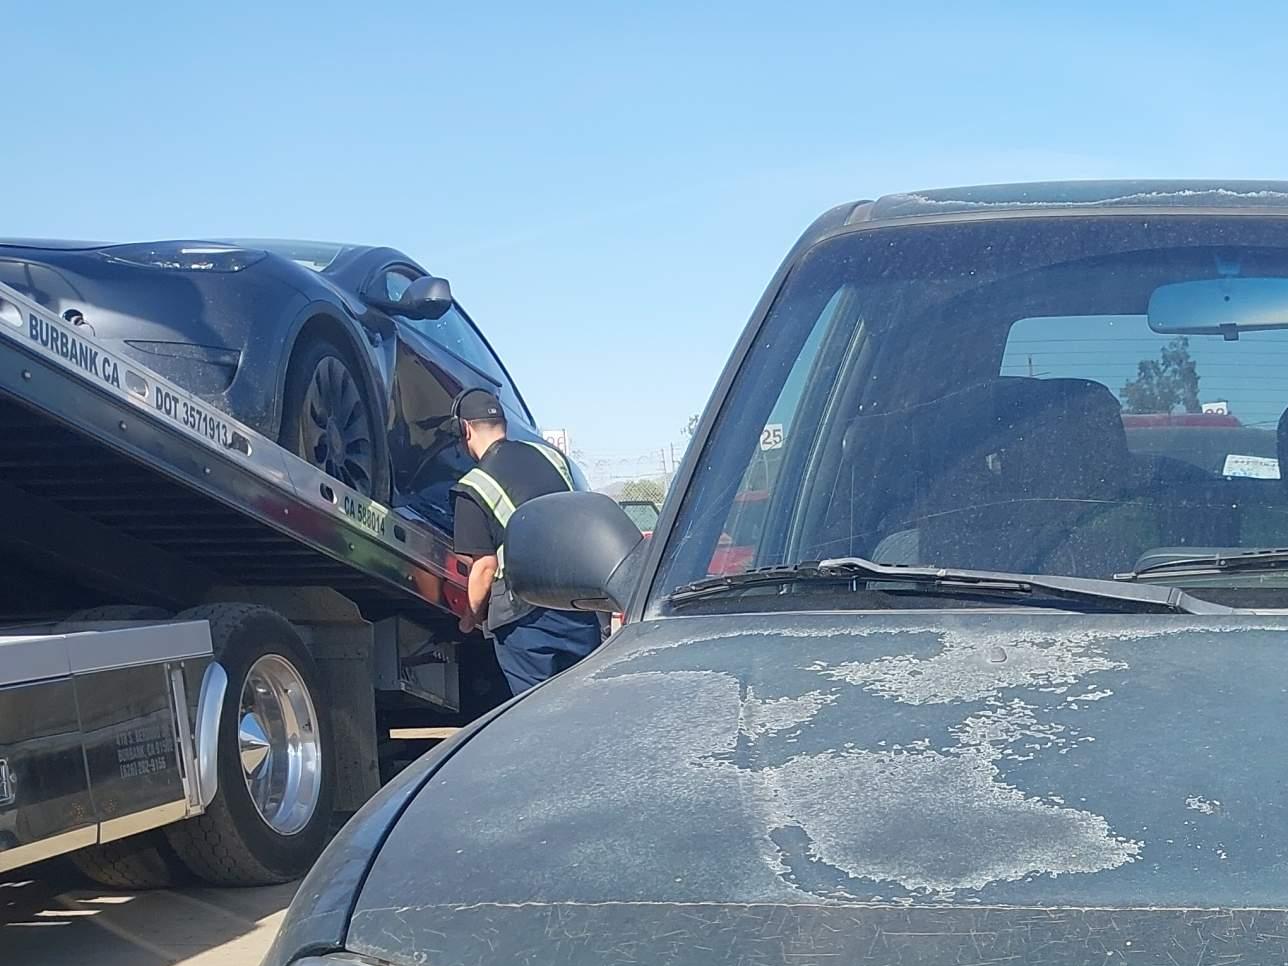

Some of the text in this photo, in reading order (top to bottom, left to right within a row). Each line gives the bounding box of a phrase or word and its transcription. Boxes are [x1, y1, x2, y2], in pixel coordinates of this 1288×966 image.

[29, 313, 121, 389] BURBANK CA
[155, 386, 228, 447] DOT 3571913
[762, 429, 782, 446] 25
[344, 495, 356, 519] CA
